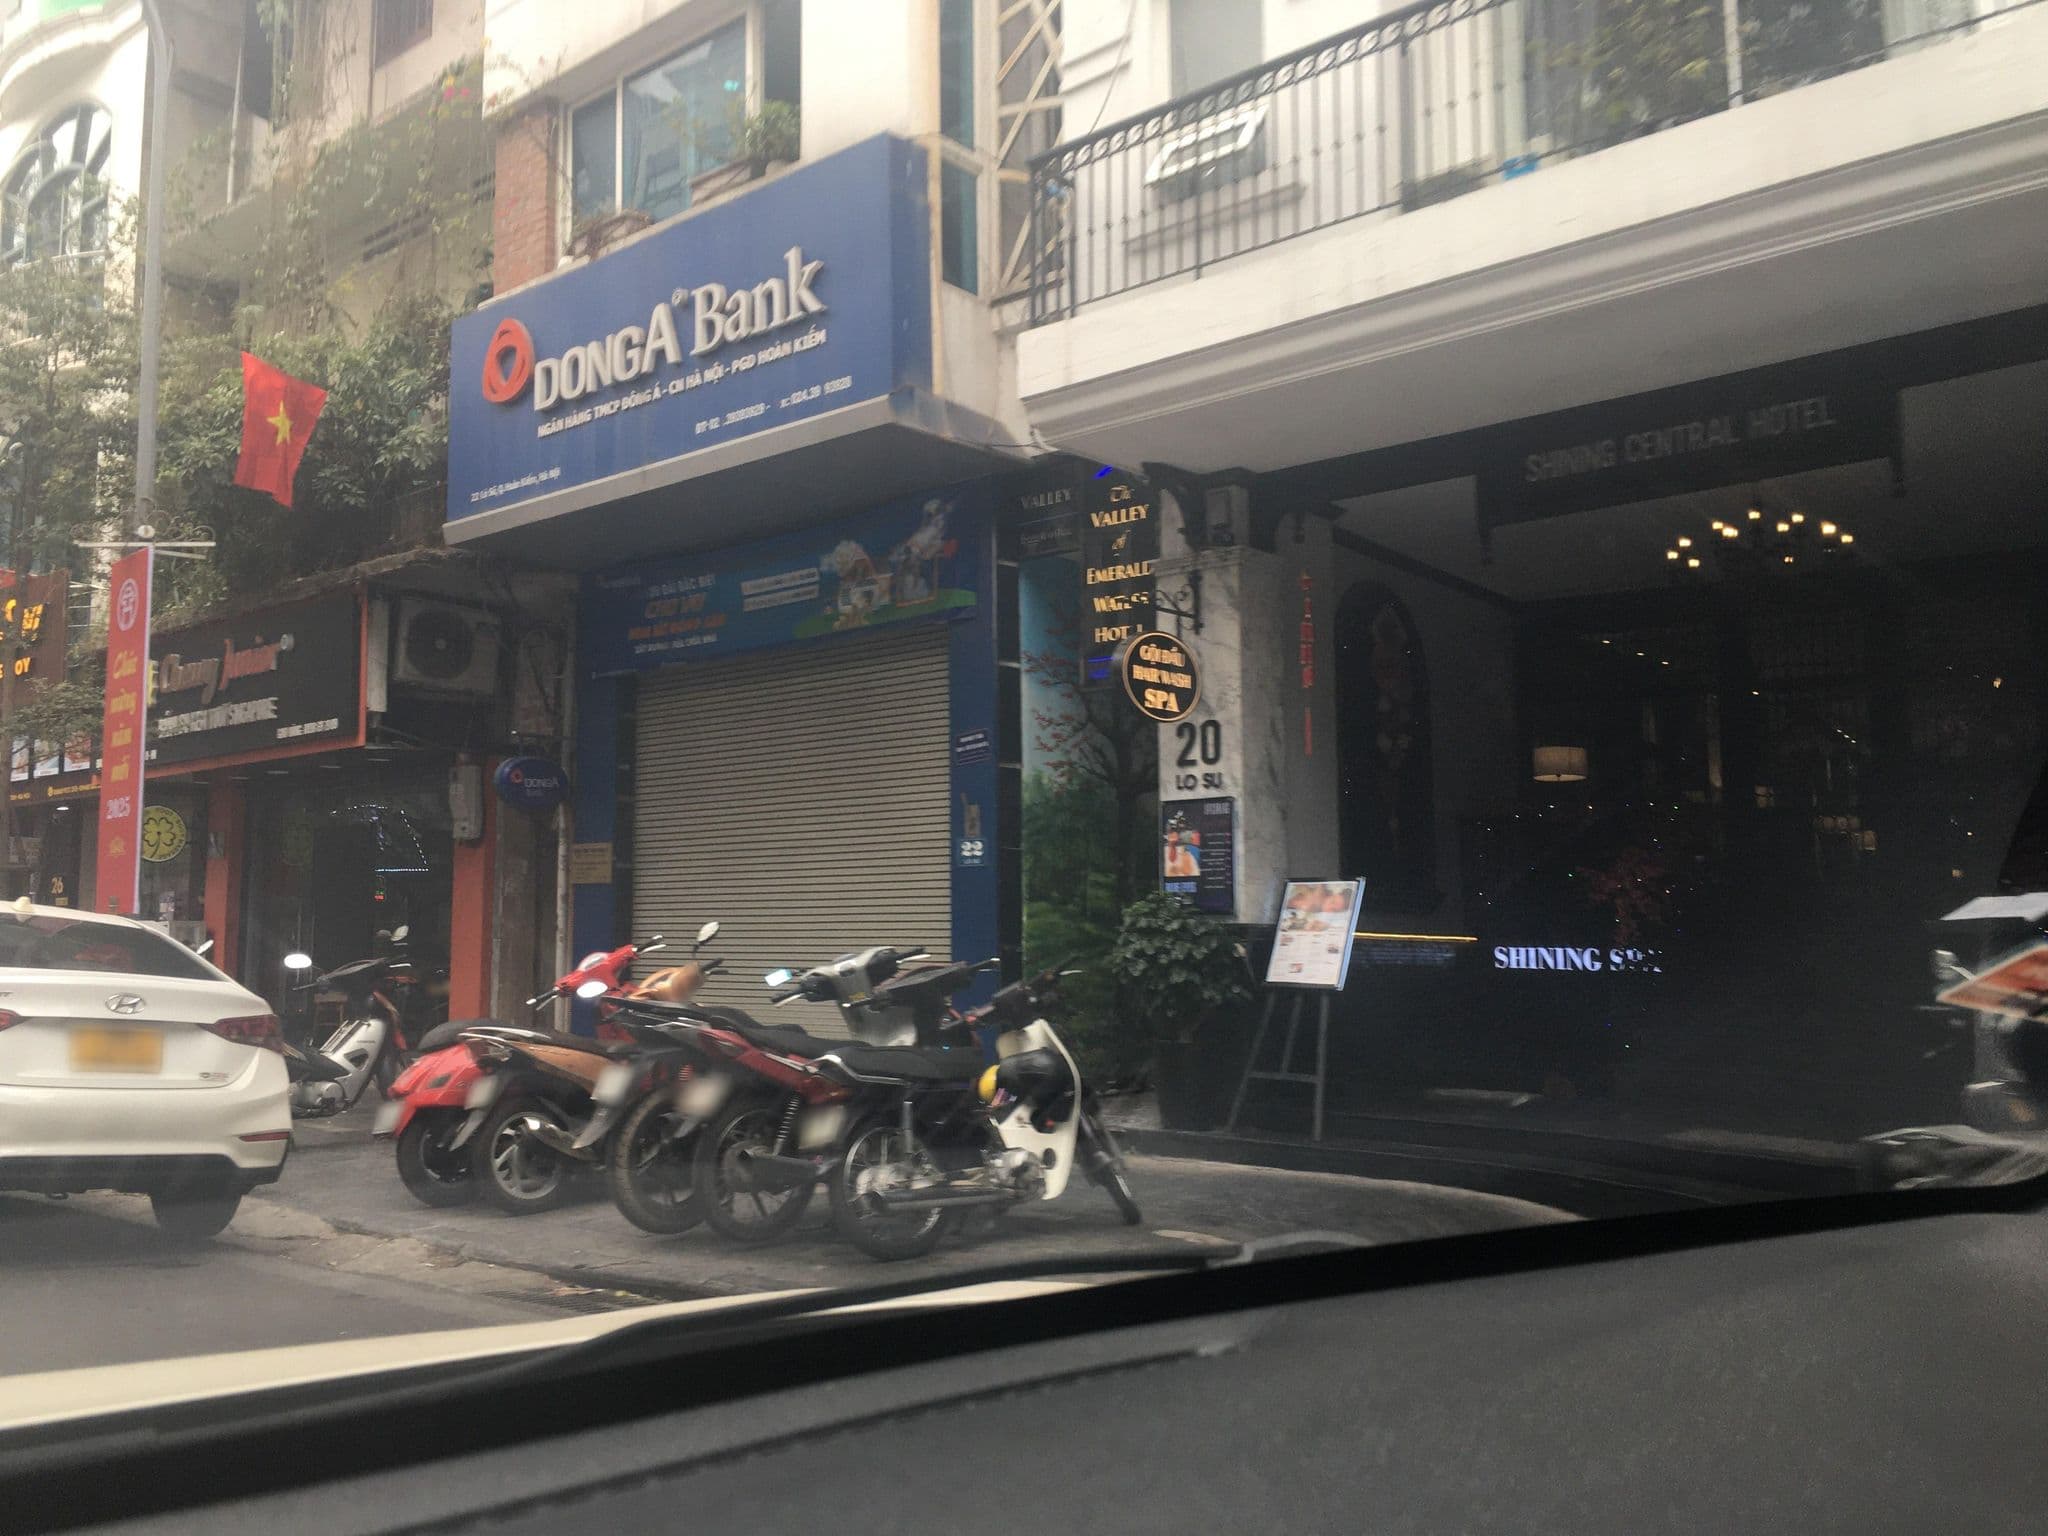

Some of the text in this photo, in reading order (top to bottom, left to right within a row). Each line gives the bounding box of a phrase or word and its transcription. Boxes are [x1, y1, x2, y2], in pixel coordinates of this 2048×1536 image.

[690, 246, 828, 356] Bank
[793, 324, 827, 354] KIẾM
[1090, 504, 1150, 528] VALLEY
[1144, 688, 1181, 712] SPA
[1176, 719, 1222, 767] 20
[1493, 946, 1603, 973] SHINING
